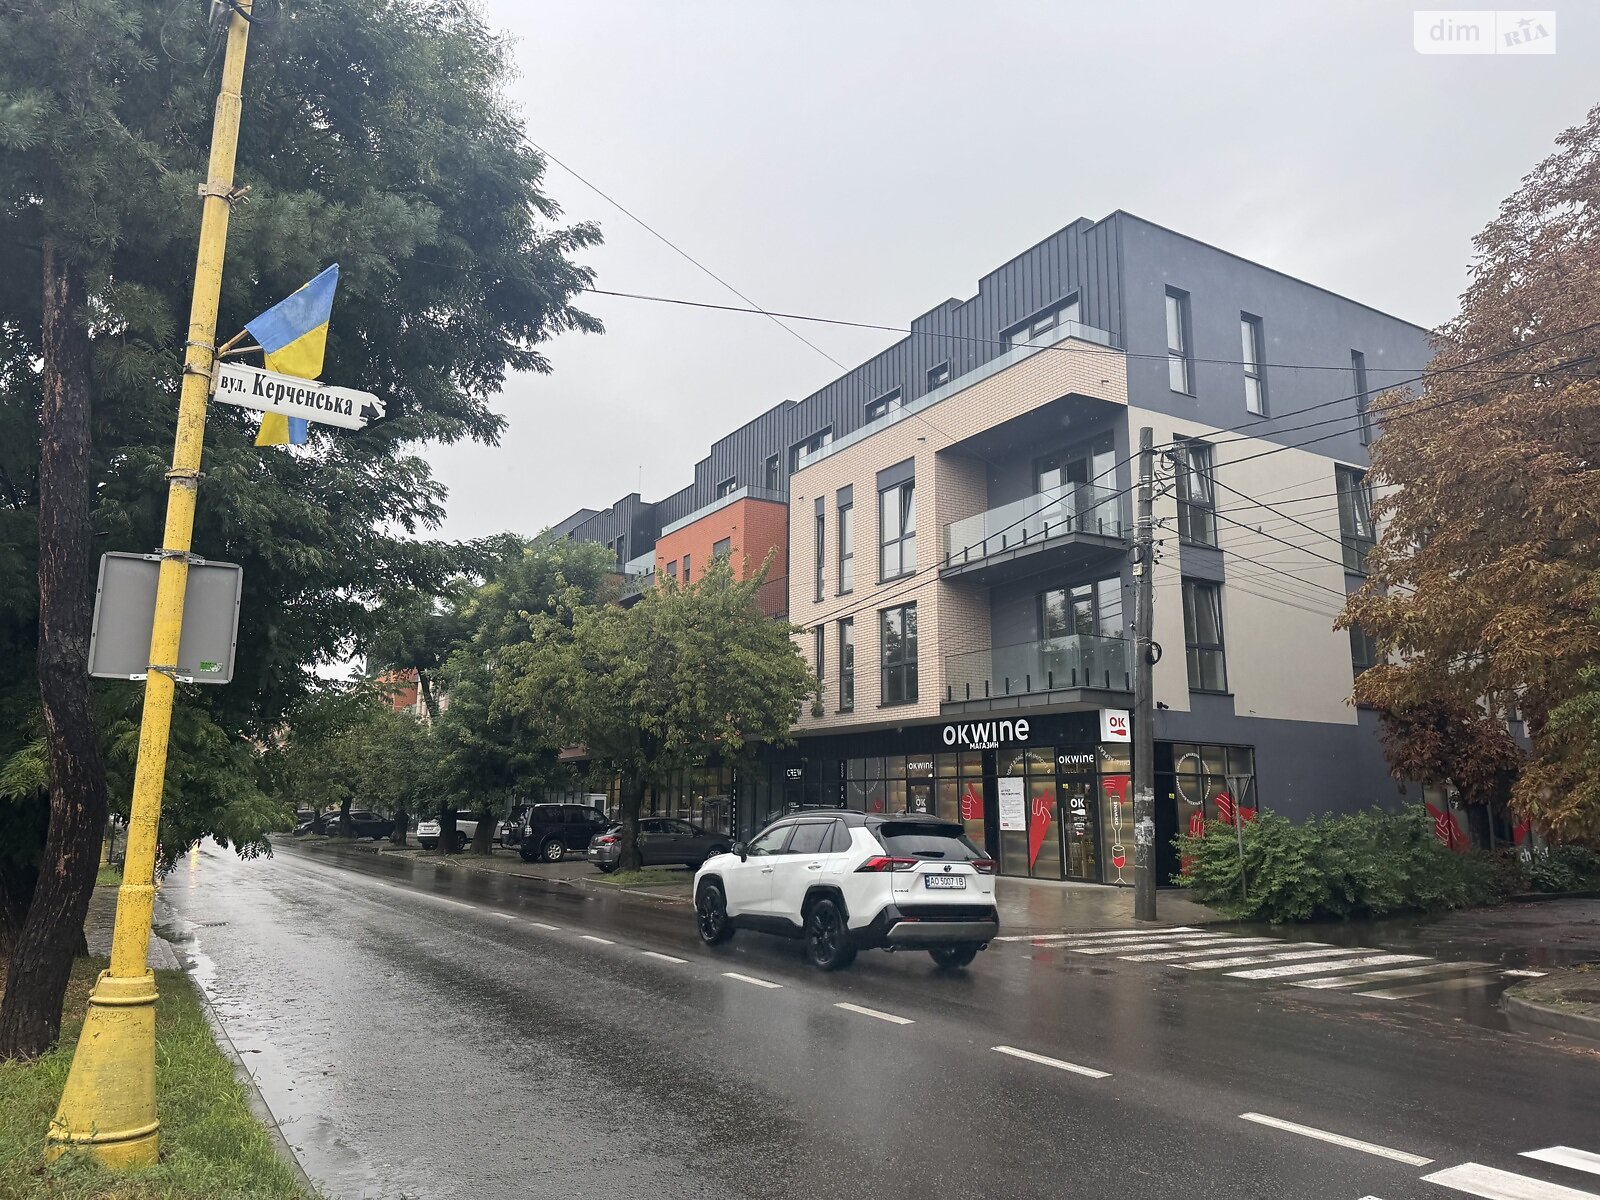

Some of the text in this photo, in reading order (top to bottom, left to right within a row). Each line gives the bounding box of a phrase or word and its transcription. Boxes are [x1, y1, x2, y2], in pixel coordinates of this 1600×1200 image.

[221, 373, 353, 416] вул. Керченська
[1109, 716, 1126, 728] OK
[969, 741, 999, 750] МАГАЗИН
[786, 768, 803, 777] CREW
[915, 798, 926, 807] OK
[1070, 798, 1085, 808] OK
[930, 877, 939, 885] AO
[940, 877, 954, 886] 5007
